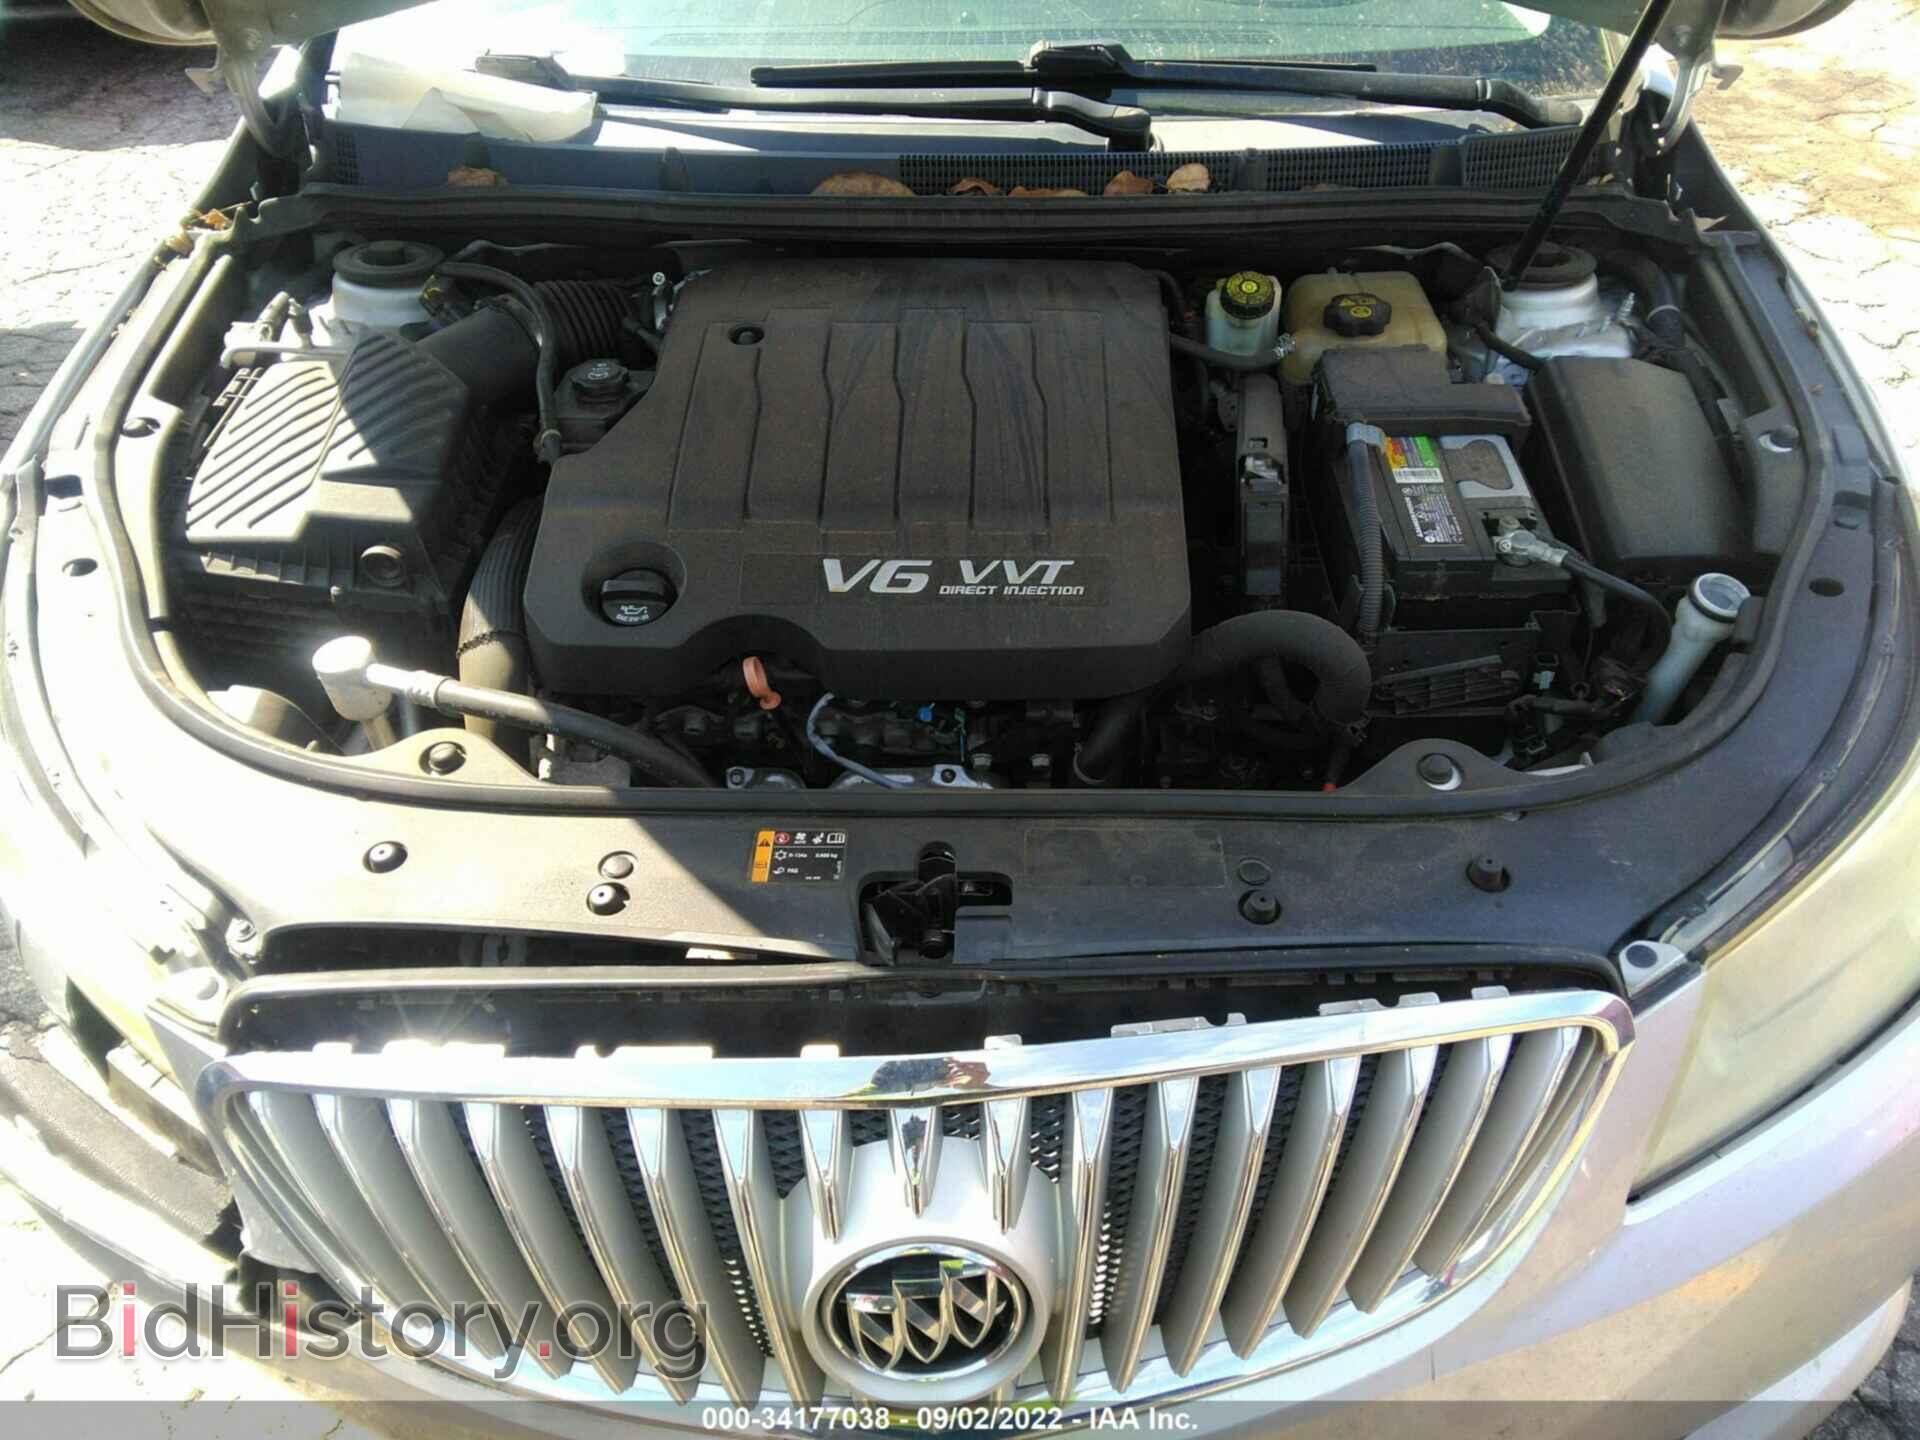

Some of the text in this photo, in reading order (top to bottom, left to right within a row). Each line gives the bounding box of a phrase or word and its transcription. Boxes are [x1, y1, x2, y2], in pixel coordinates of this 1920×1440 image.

[822, 558, 1075, 593] V6 VVT
[939, 585, 1085, 596] DIRECT INJECTION
